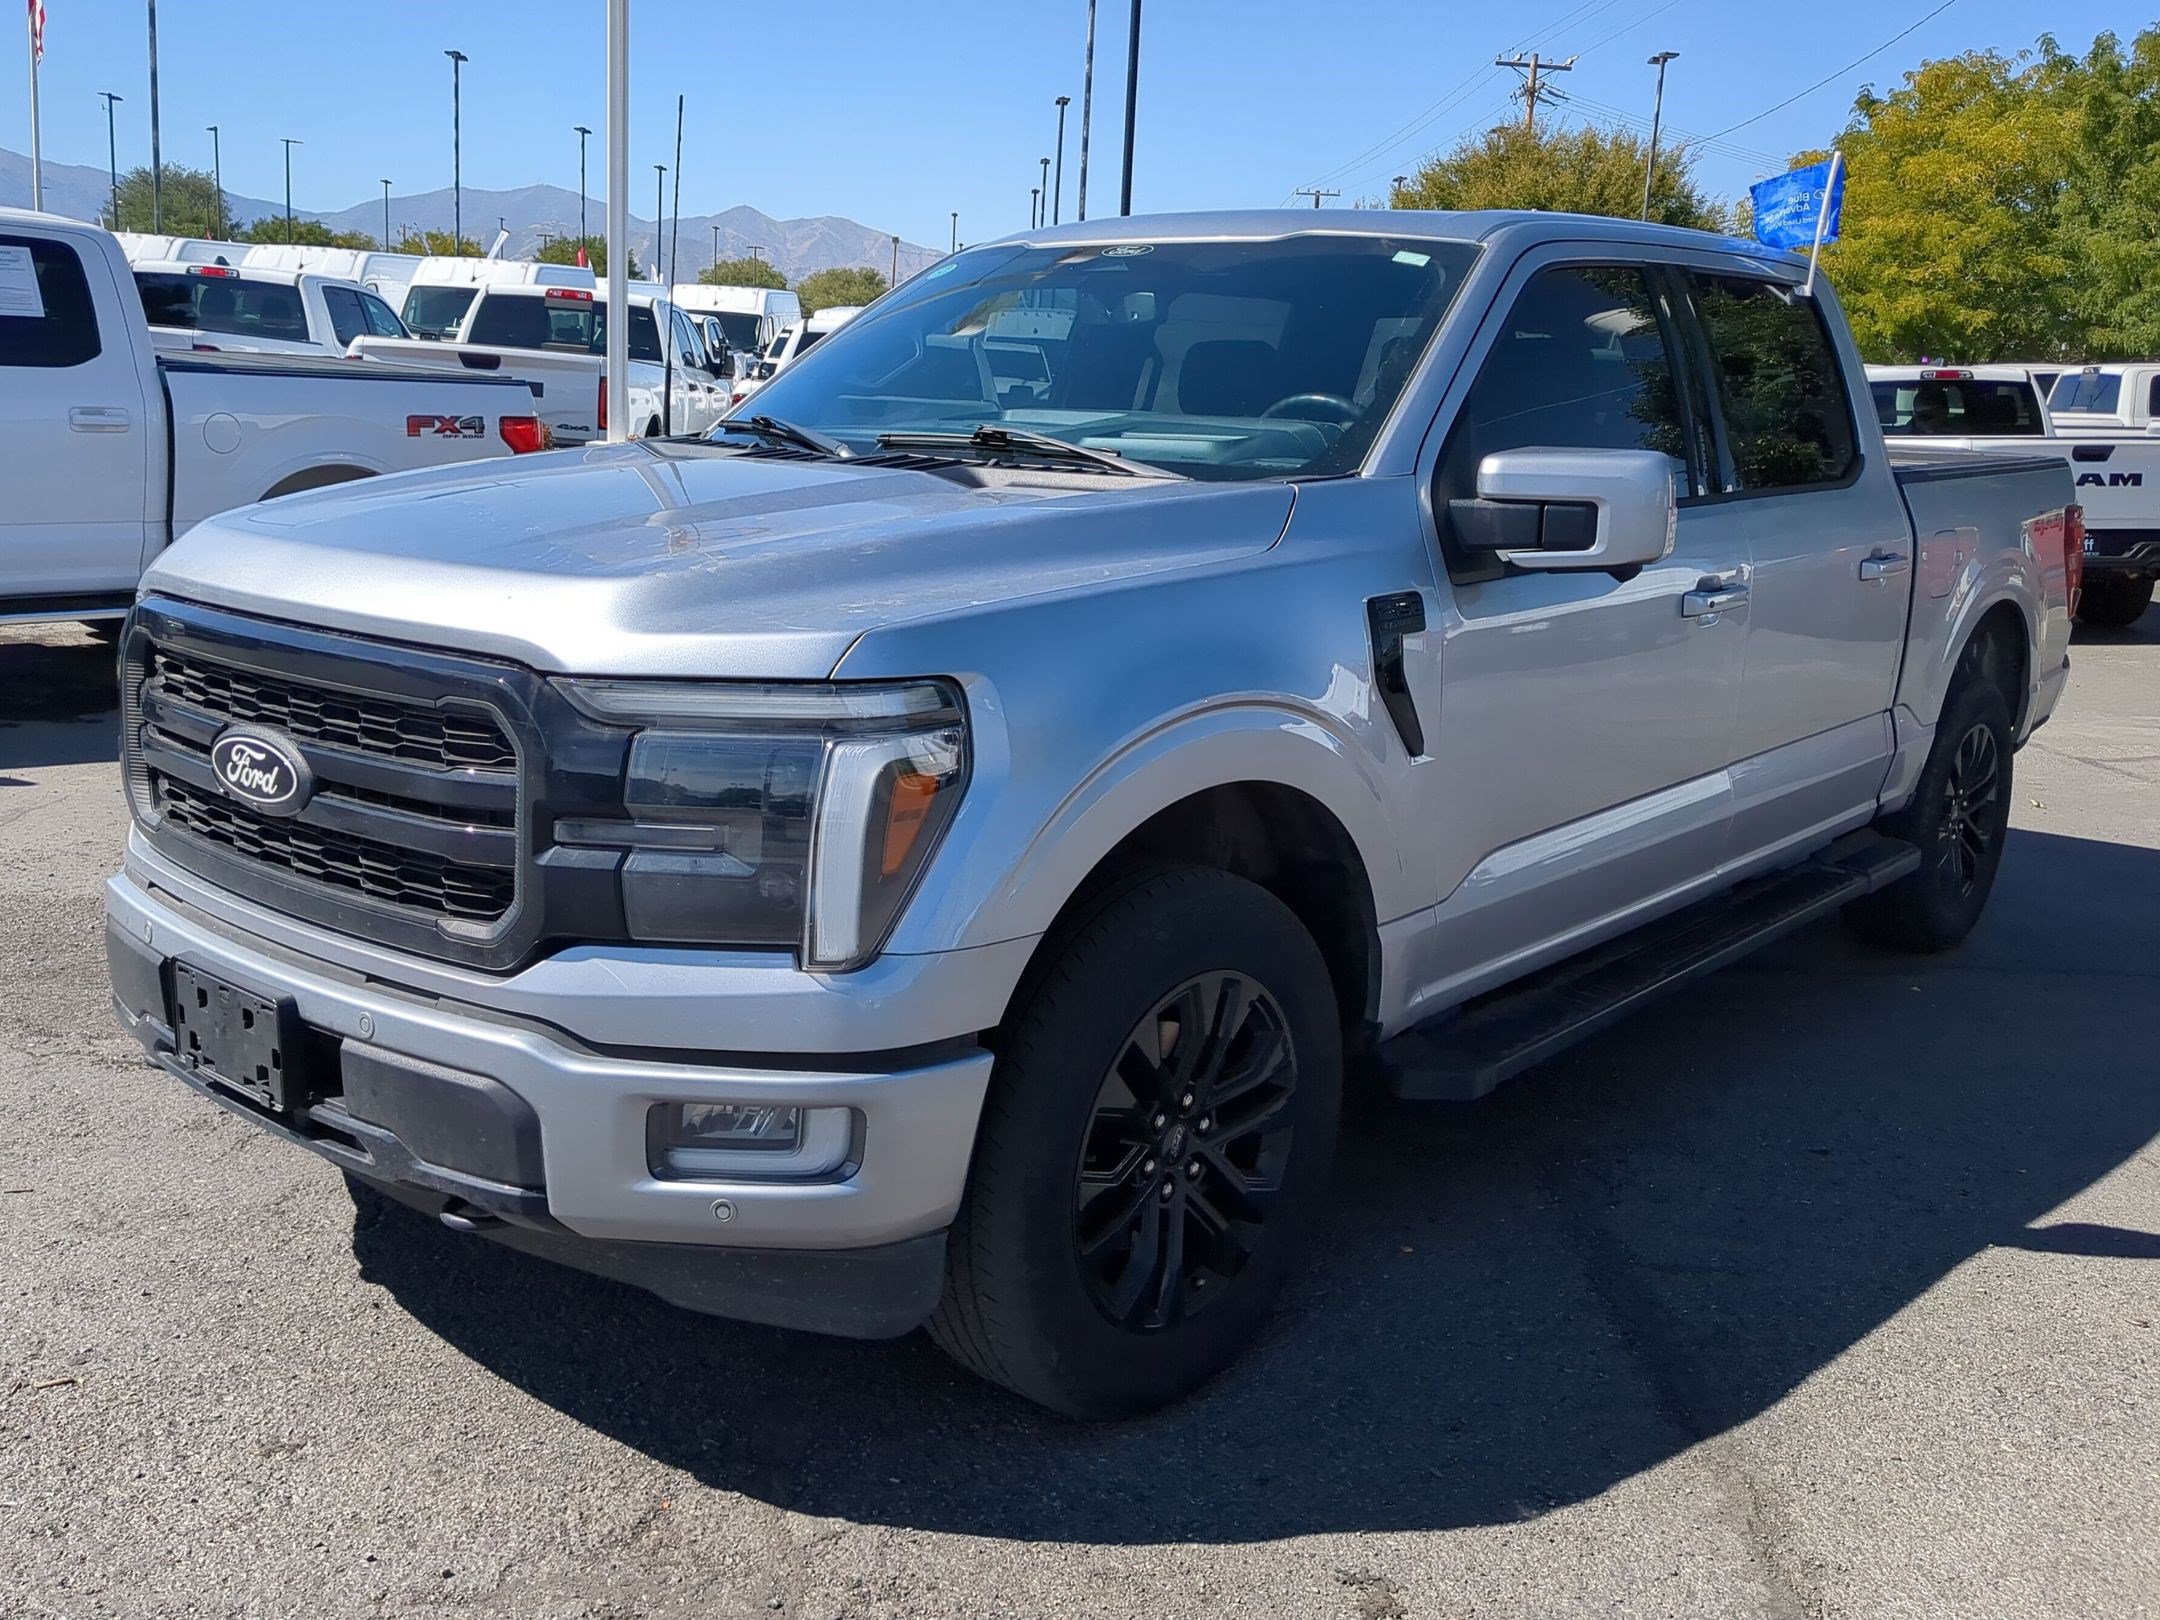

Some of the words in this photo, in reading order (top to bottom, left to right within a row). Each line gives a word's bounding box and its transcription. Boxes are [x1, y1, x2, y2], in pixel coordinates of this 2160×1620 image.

[1108, 245, 1146, 256] Ford
[406, 415, 485, 437] FX4
[2075, 472, 2143, 487] AM
[226, 743, 279, 795] Ford
